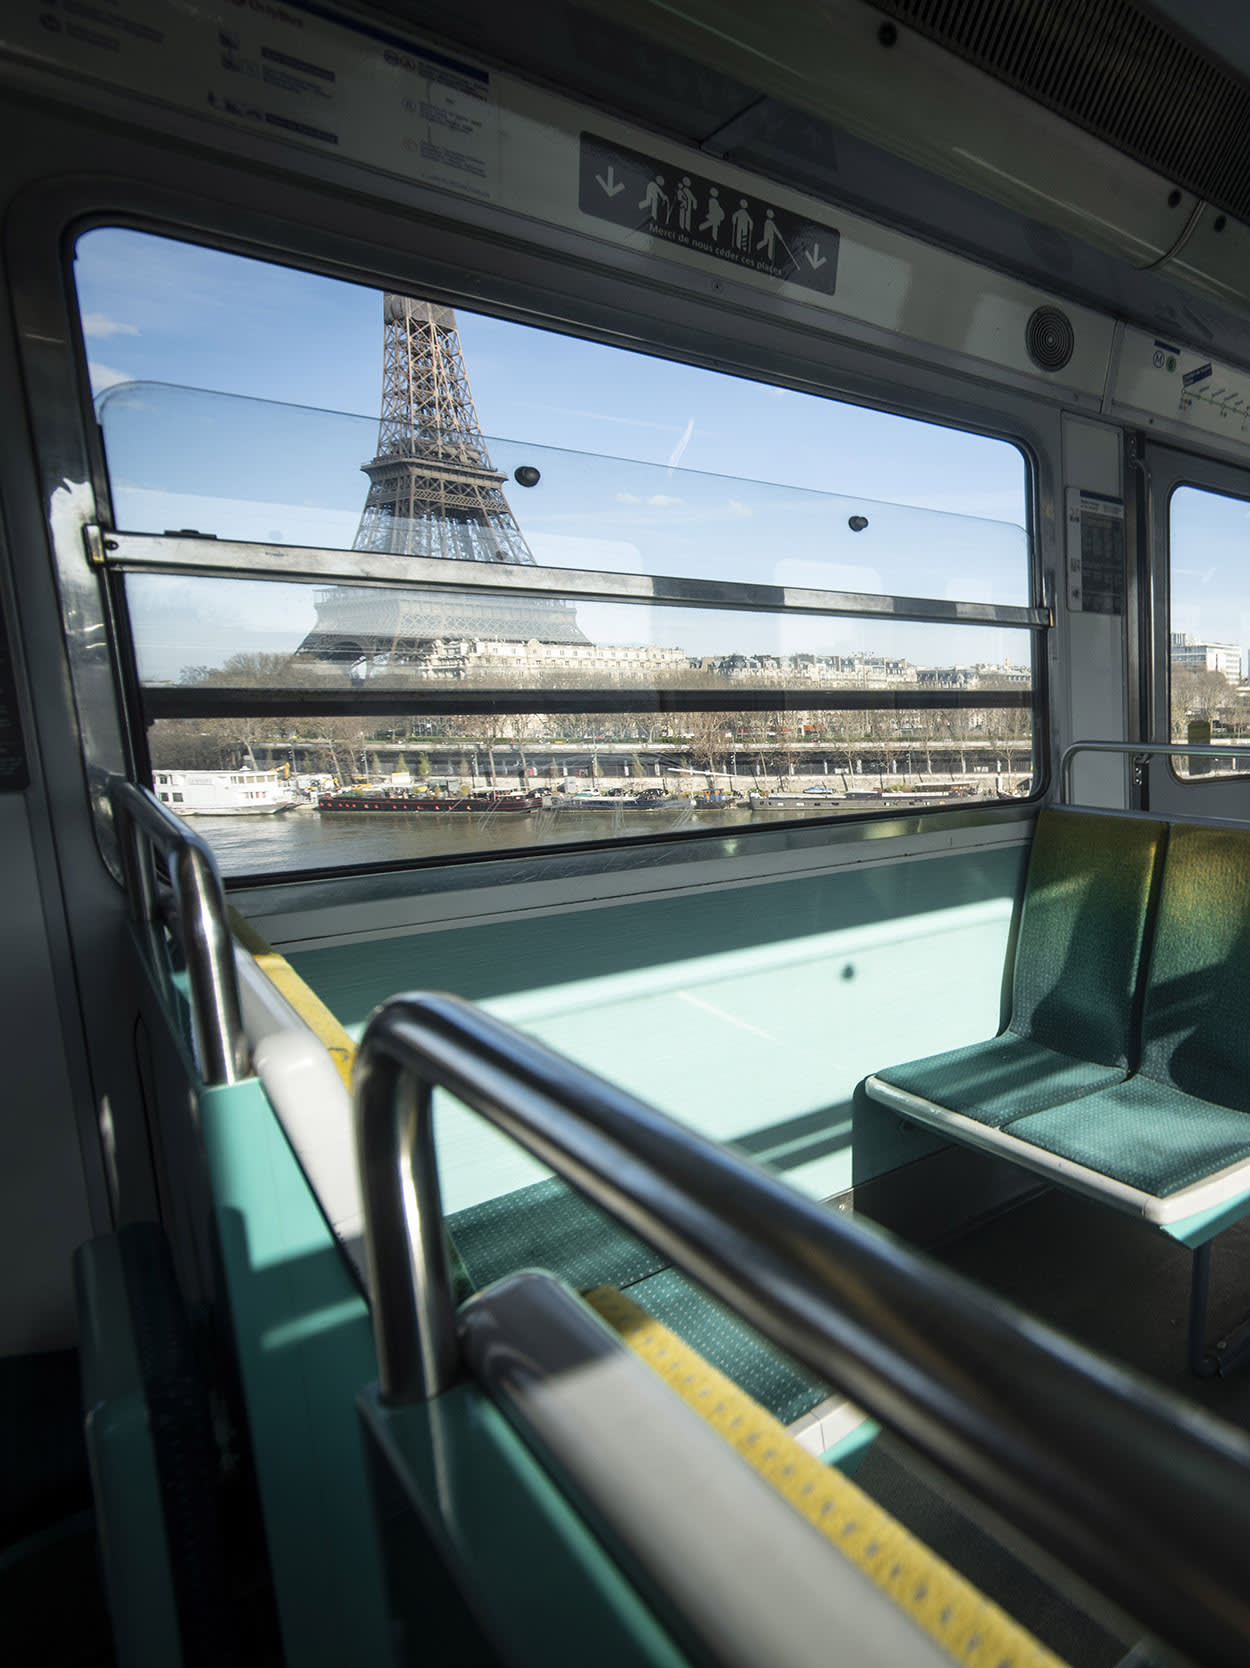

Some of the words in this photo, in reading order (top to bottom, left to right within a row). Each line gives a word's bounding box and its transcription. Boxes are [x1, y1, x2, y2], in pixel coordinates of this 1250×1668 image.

[649, 223, 677, 240] Merci
[678, 232, 689, 243] de
[692, 240, 713, 252] nous
[715, 246, 739, 260] céder
[741, 255, 755, 266] ces
[756, 260, 783, 275] places
